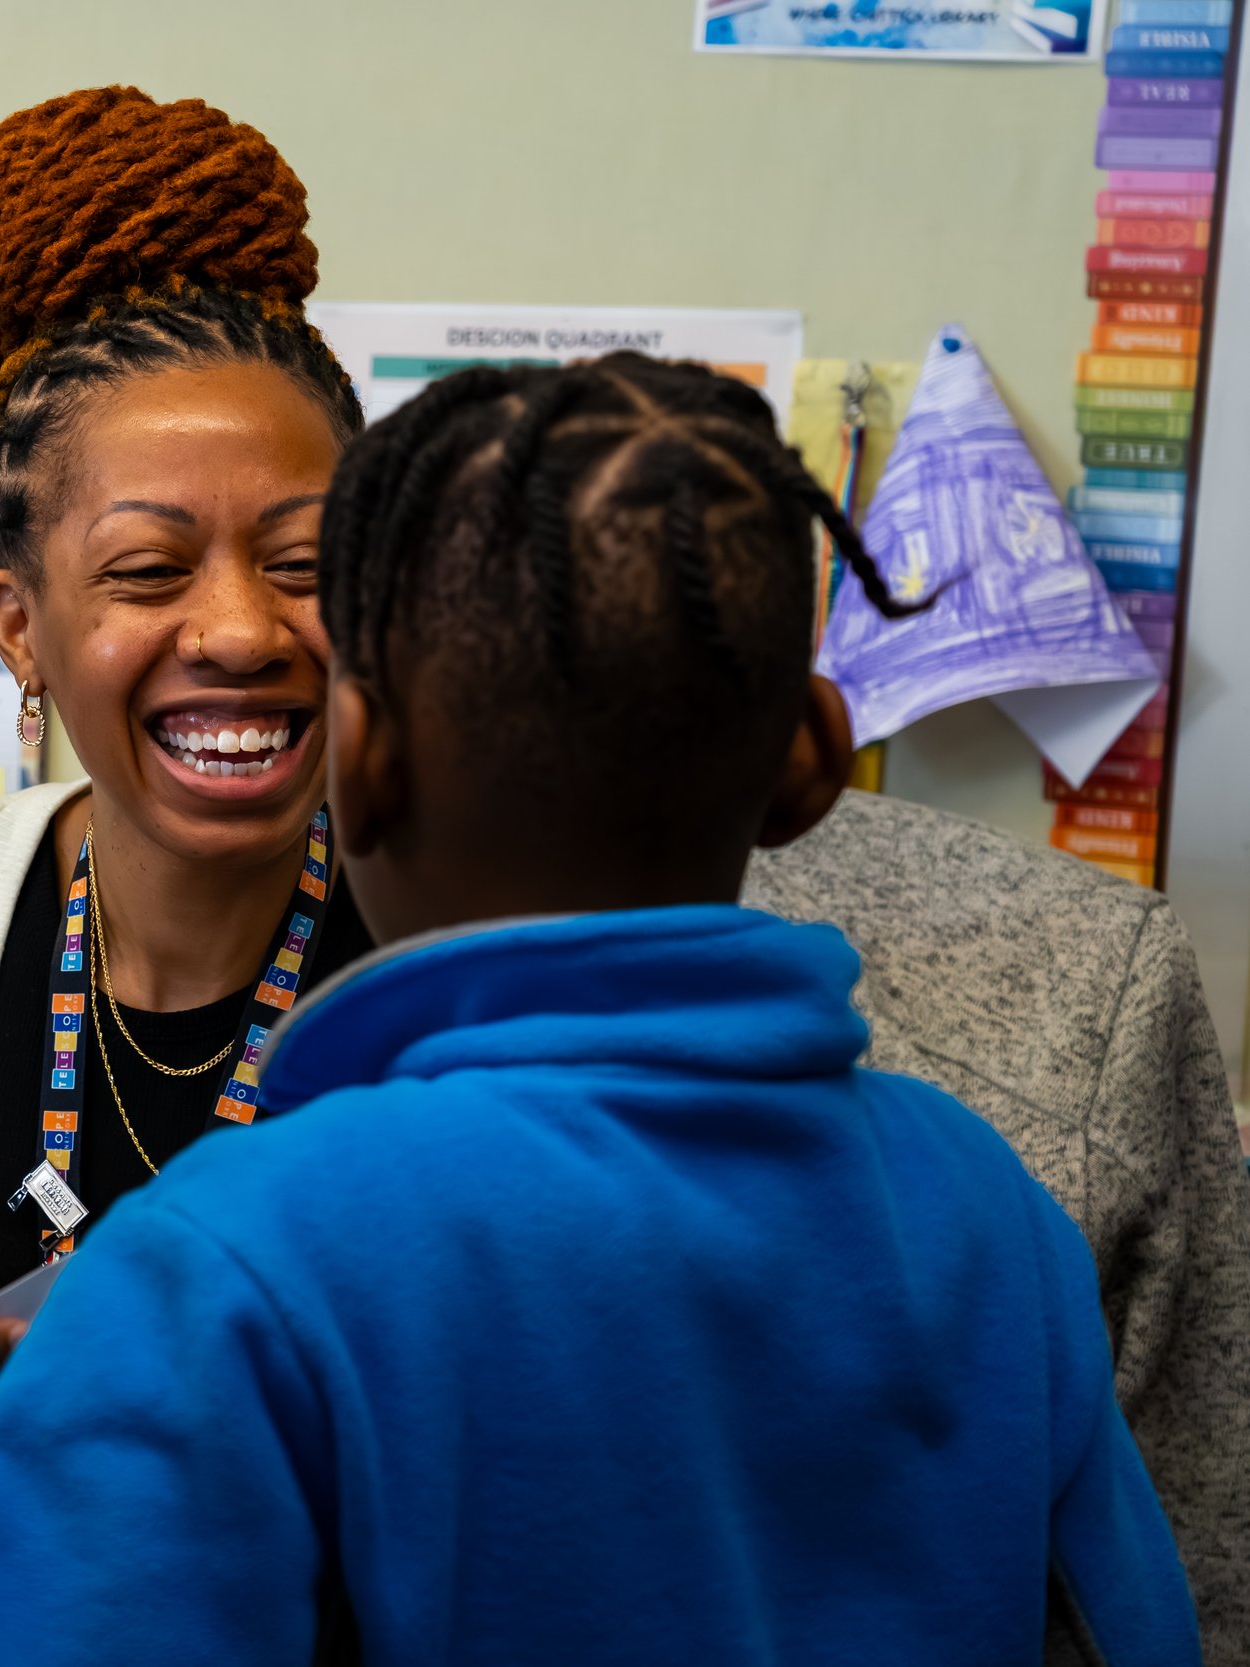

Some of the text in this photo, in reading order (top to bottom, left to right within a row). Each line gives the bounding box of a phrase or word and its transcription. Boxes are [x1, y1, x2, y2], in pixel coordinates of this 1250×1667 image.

[447, 327, 663, 350] DESCION QUADRANT
[58, 994, 73, 1088] TELESCOPE
